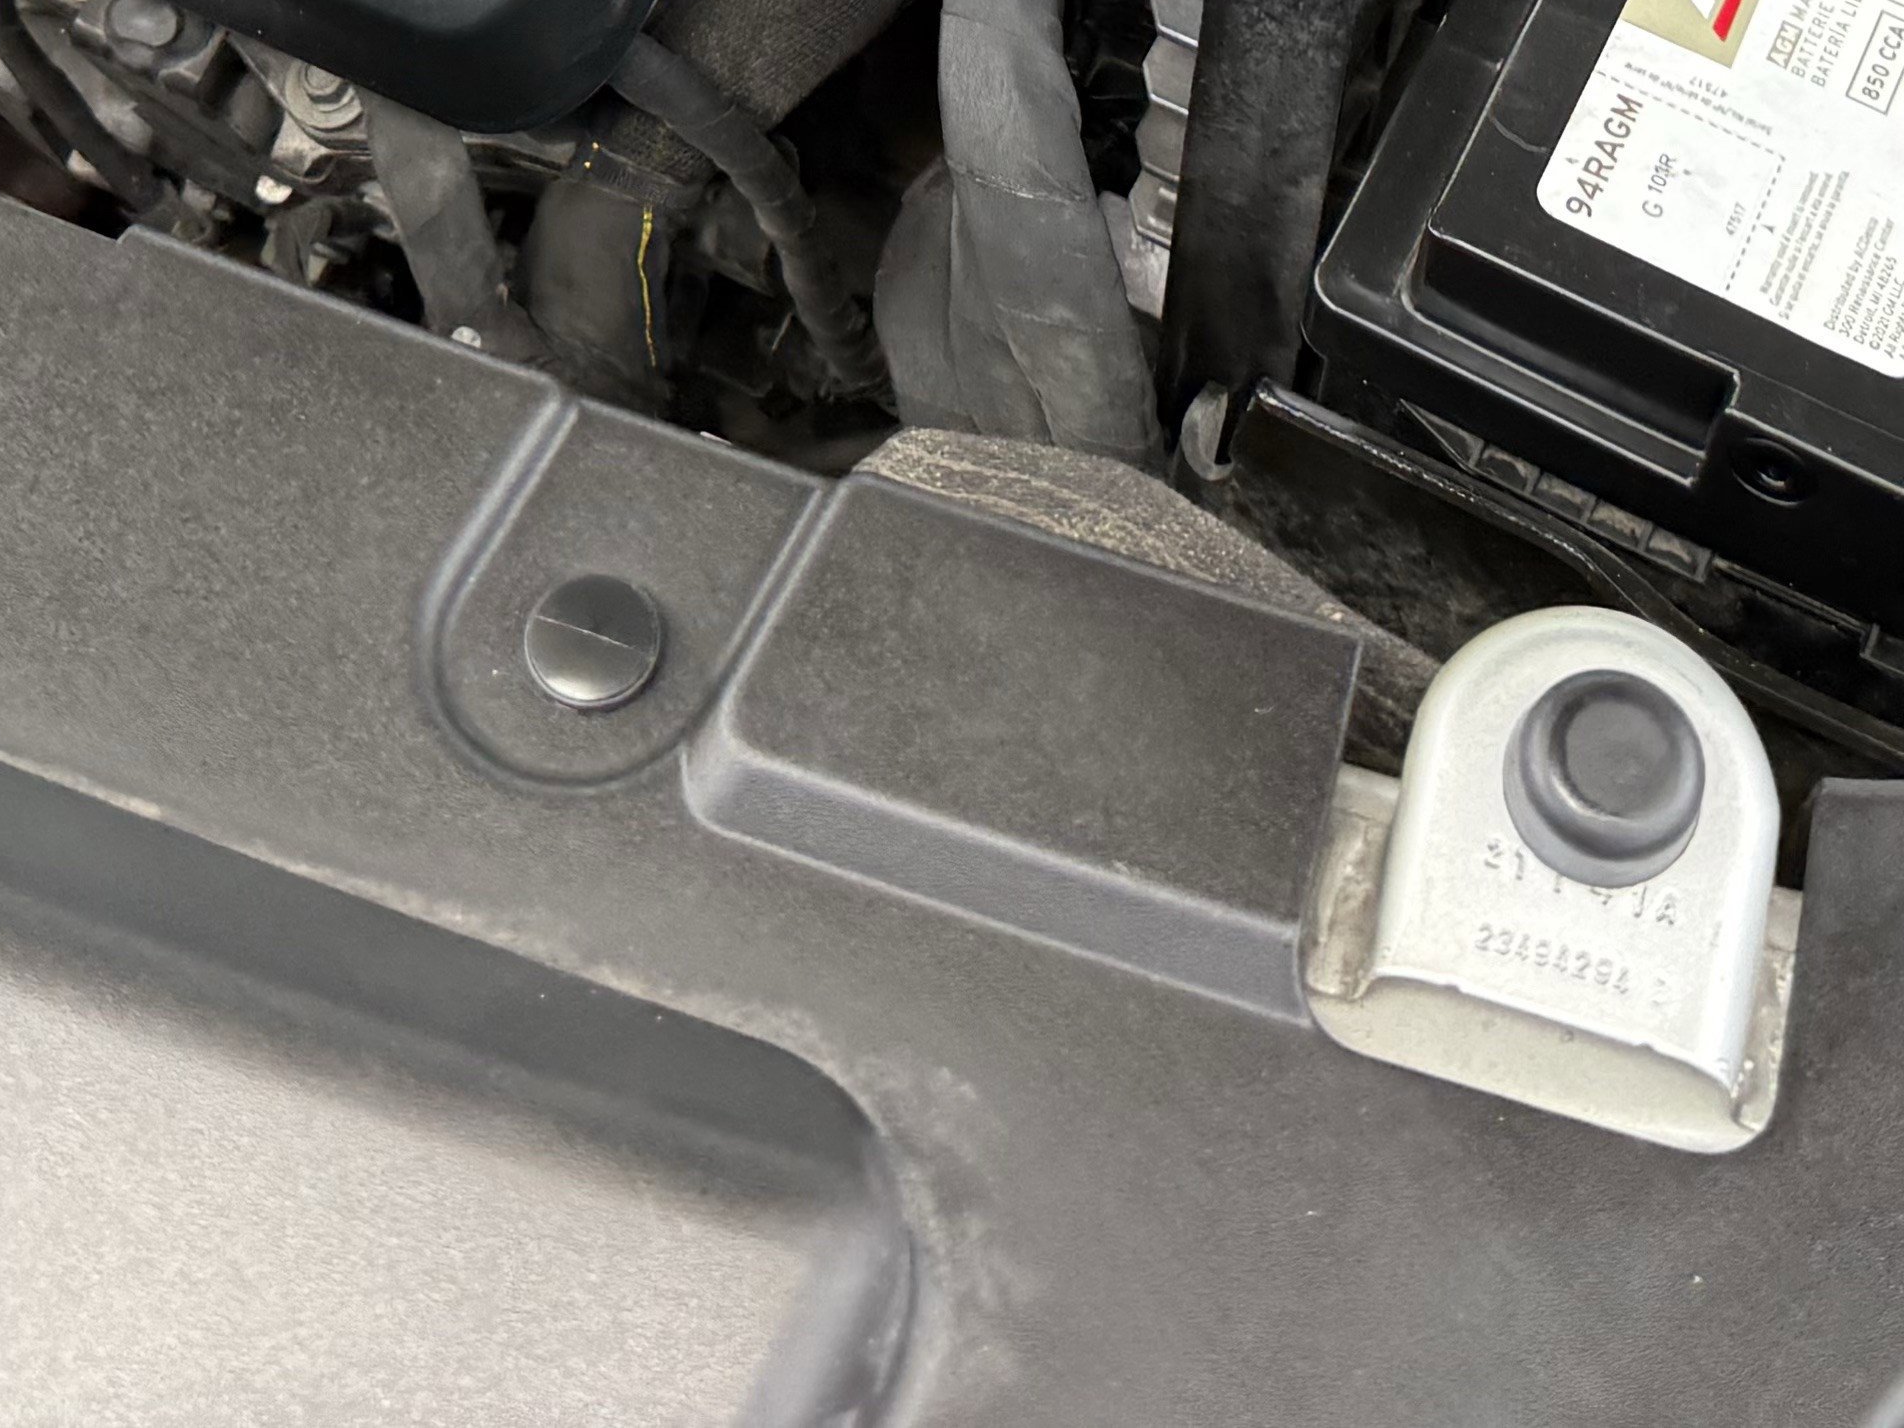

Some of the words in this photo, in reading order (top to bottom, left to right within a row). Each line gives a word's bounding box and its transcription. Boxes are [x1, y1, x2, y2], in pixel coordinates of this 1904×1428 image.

[1788, 1, 1836, 80] BATTERIE
[1807, 16, 1852, 88] BATERÍA
[1858, 61, 1891, 102] 850
[1559, 91, 1648, 221] 94RAGM
[1639, 196, 1666, 220] G
[1836, 312, 1857, 338] 300
